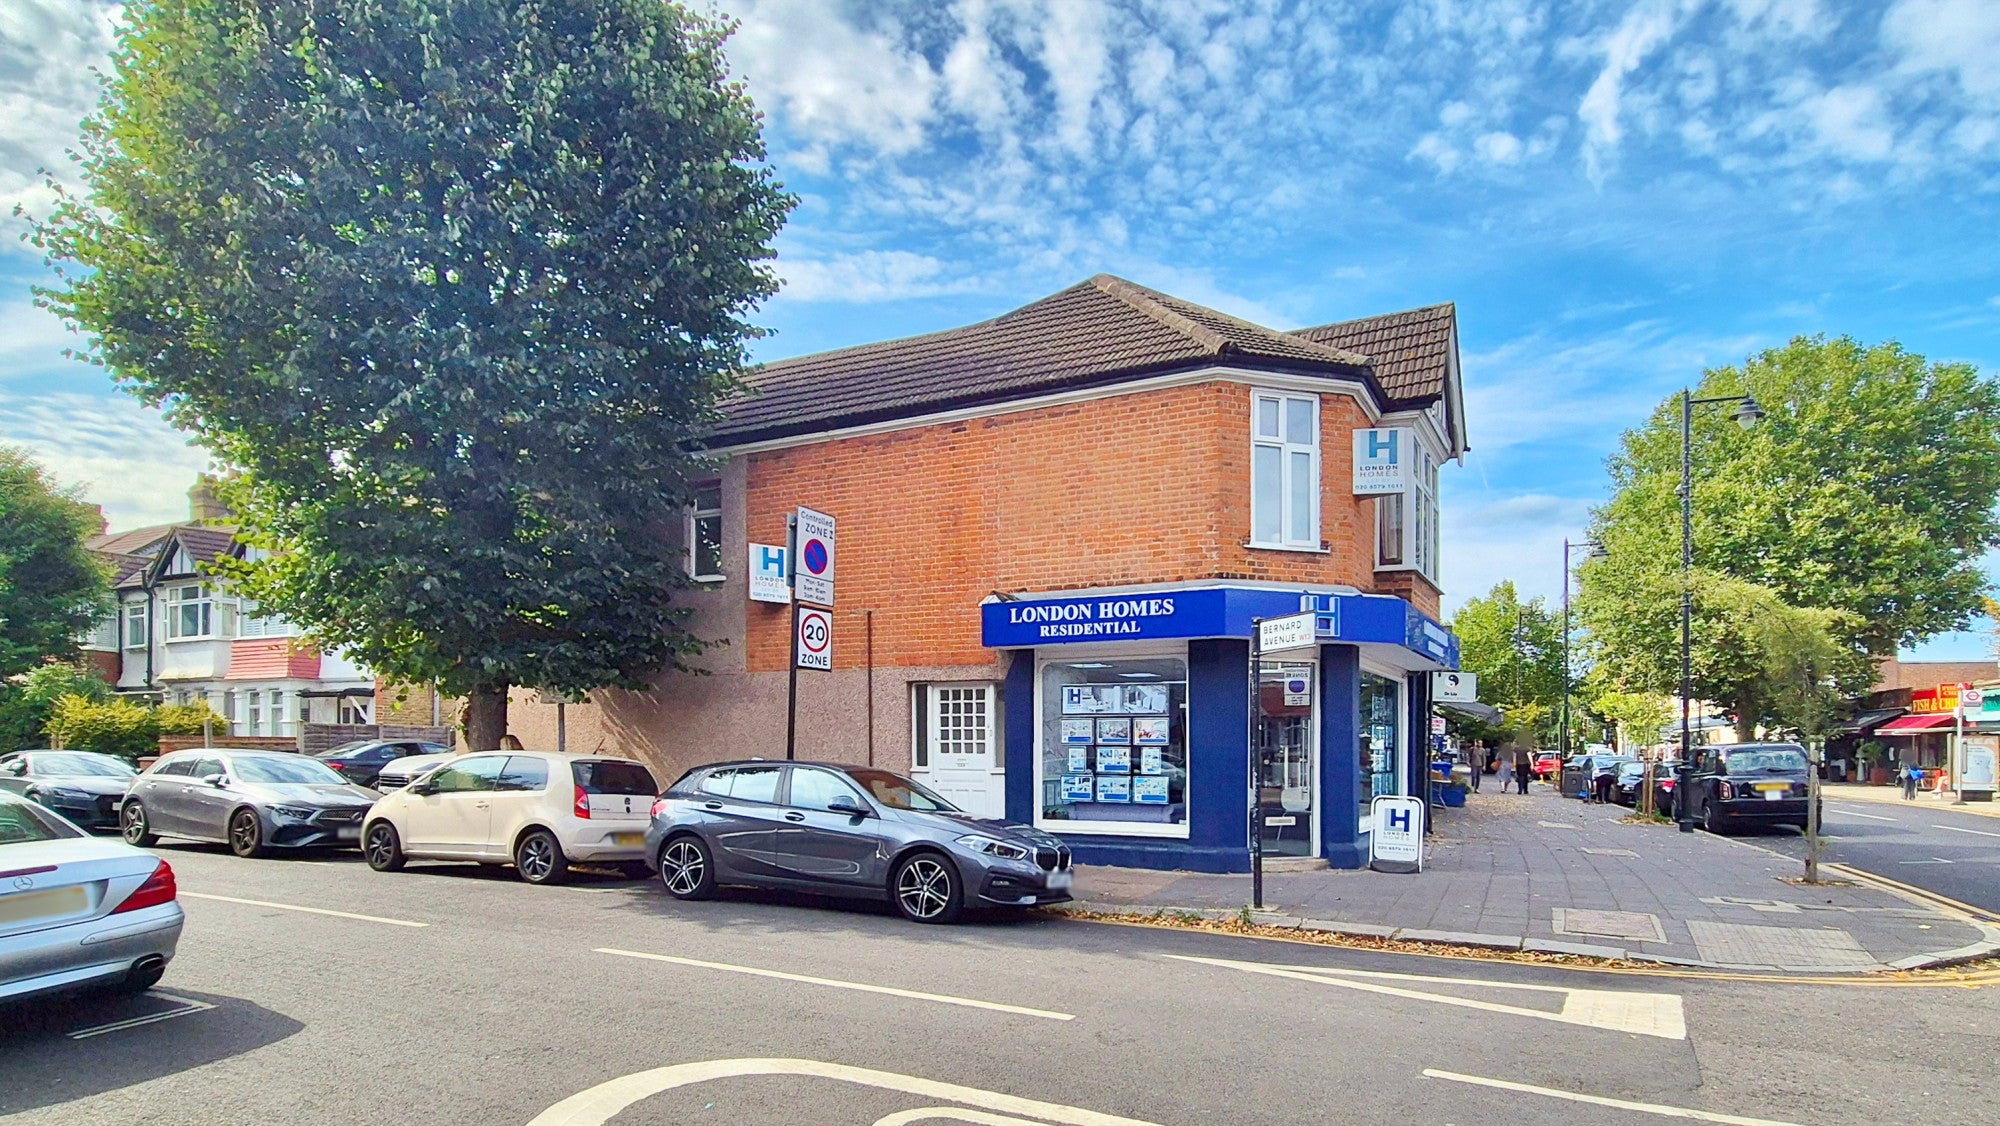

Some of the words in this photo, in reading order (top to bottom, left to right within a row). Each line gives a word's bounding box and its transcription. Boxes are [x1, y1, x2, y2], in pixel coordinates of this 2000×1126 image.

[801, 511, 833, 528] Controlled
[805, 523, 827, 538] ZONE
[1009, 603, 1092, 623] LONDON
[1098, 598, 1175, 618] HOMES
[805, 624, 825, 642] 20
[1039, 620, 1141, 637] RESIDENTIAL
[1263, 621, 1302, 634] BERNARD
[1264, 634, 1296, 646] AVENUE
[801, 653, 828, 666] ZONE
[1913, 699, 1930, 712] FISH
[1931, 697, 1938, 711] &
